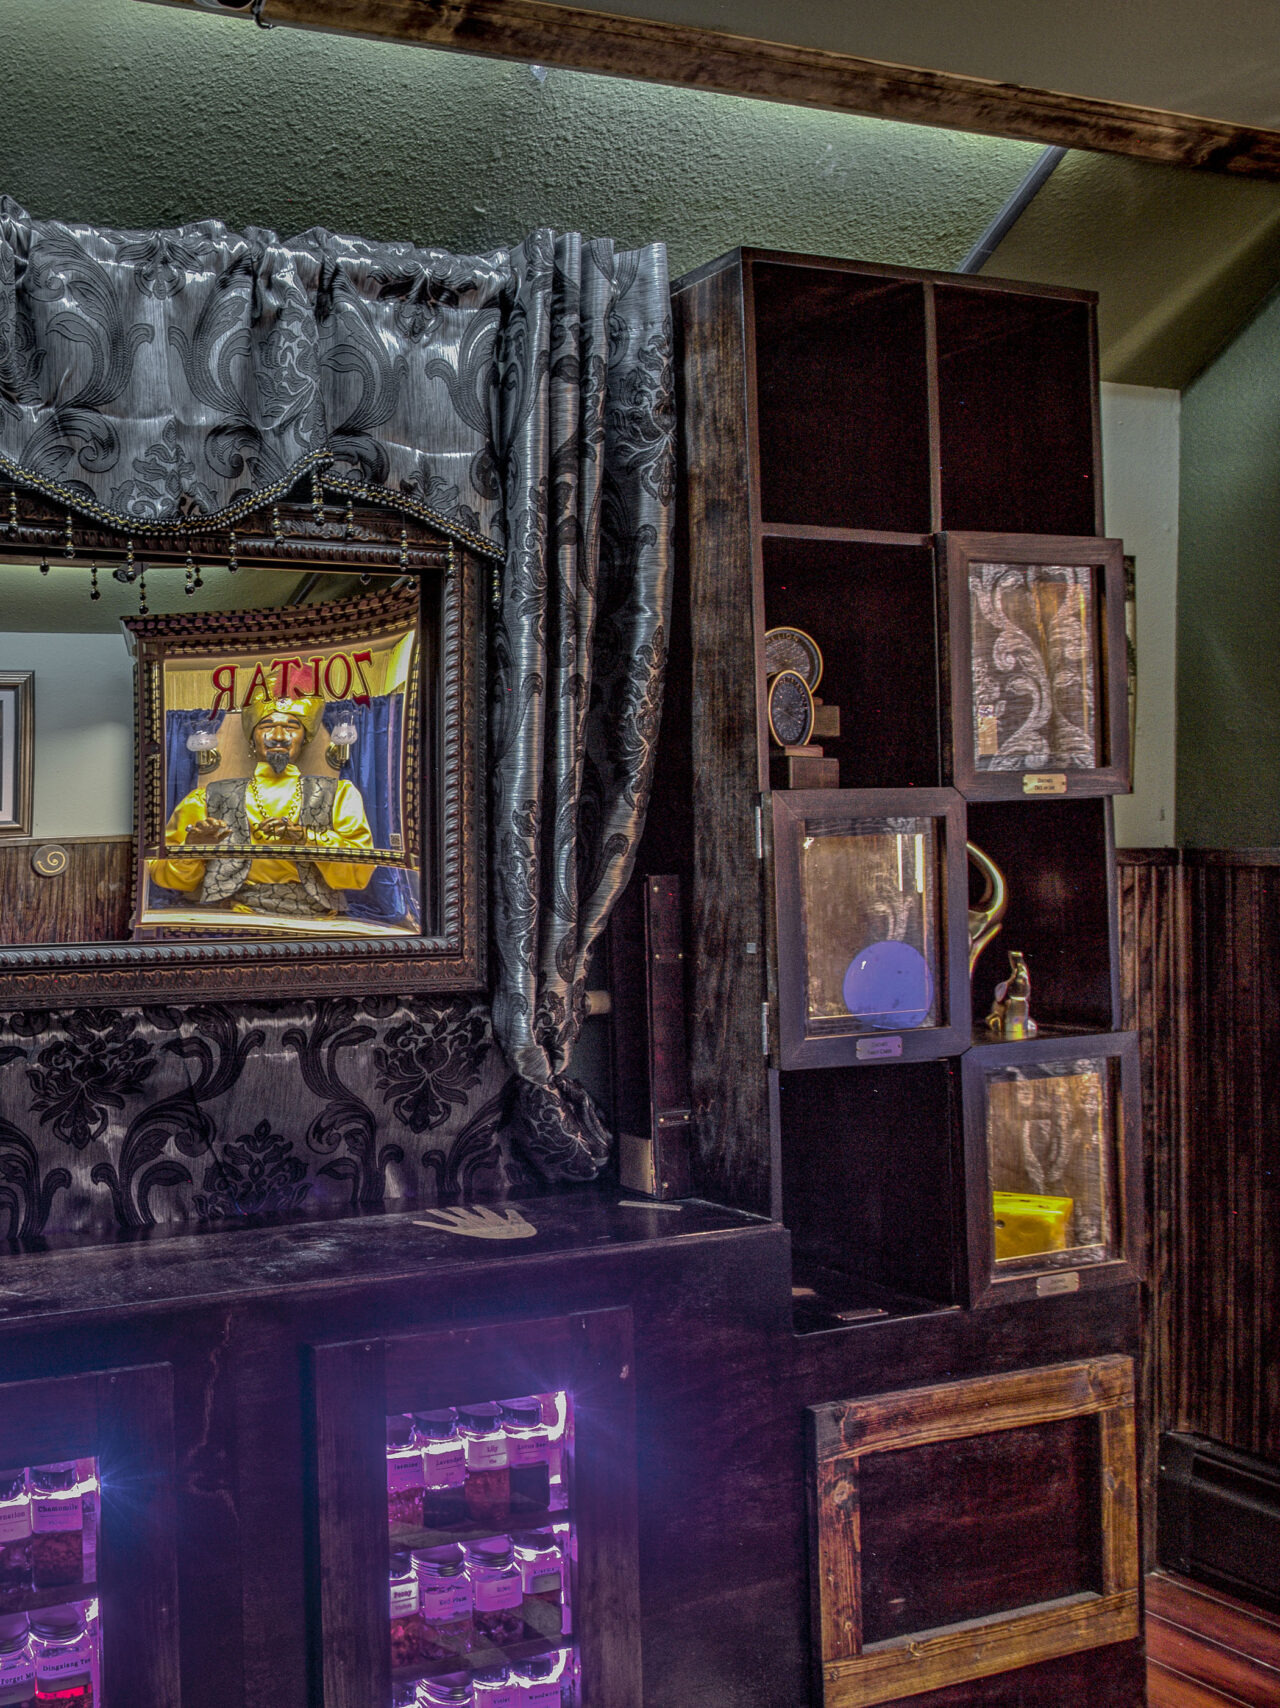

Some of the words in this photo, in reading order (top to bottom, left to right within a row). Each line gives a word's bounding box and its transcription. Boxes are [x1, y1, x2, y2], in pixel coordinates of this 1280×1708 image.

[436, 1457, 463, 1466] Lavender
[37, 1503, 78, 1513] Chamomile
[1, 1675, 23, 1685] Forget
